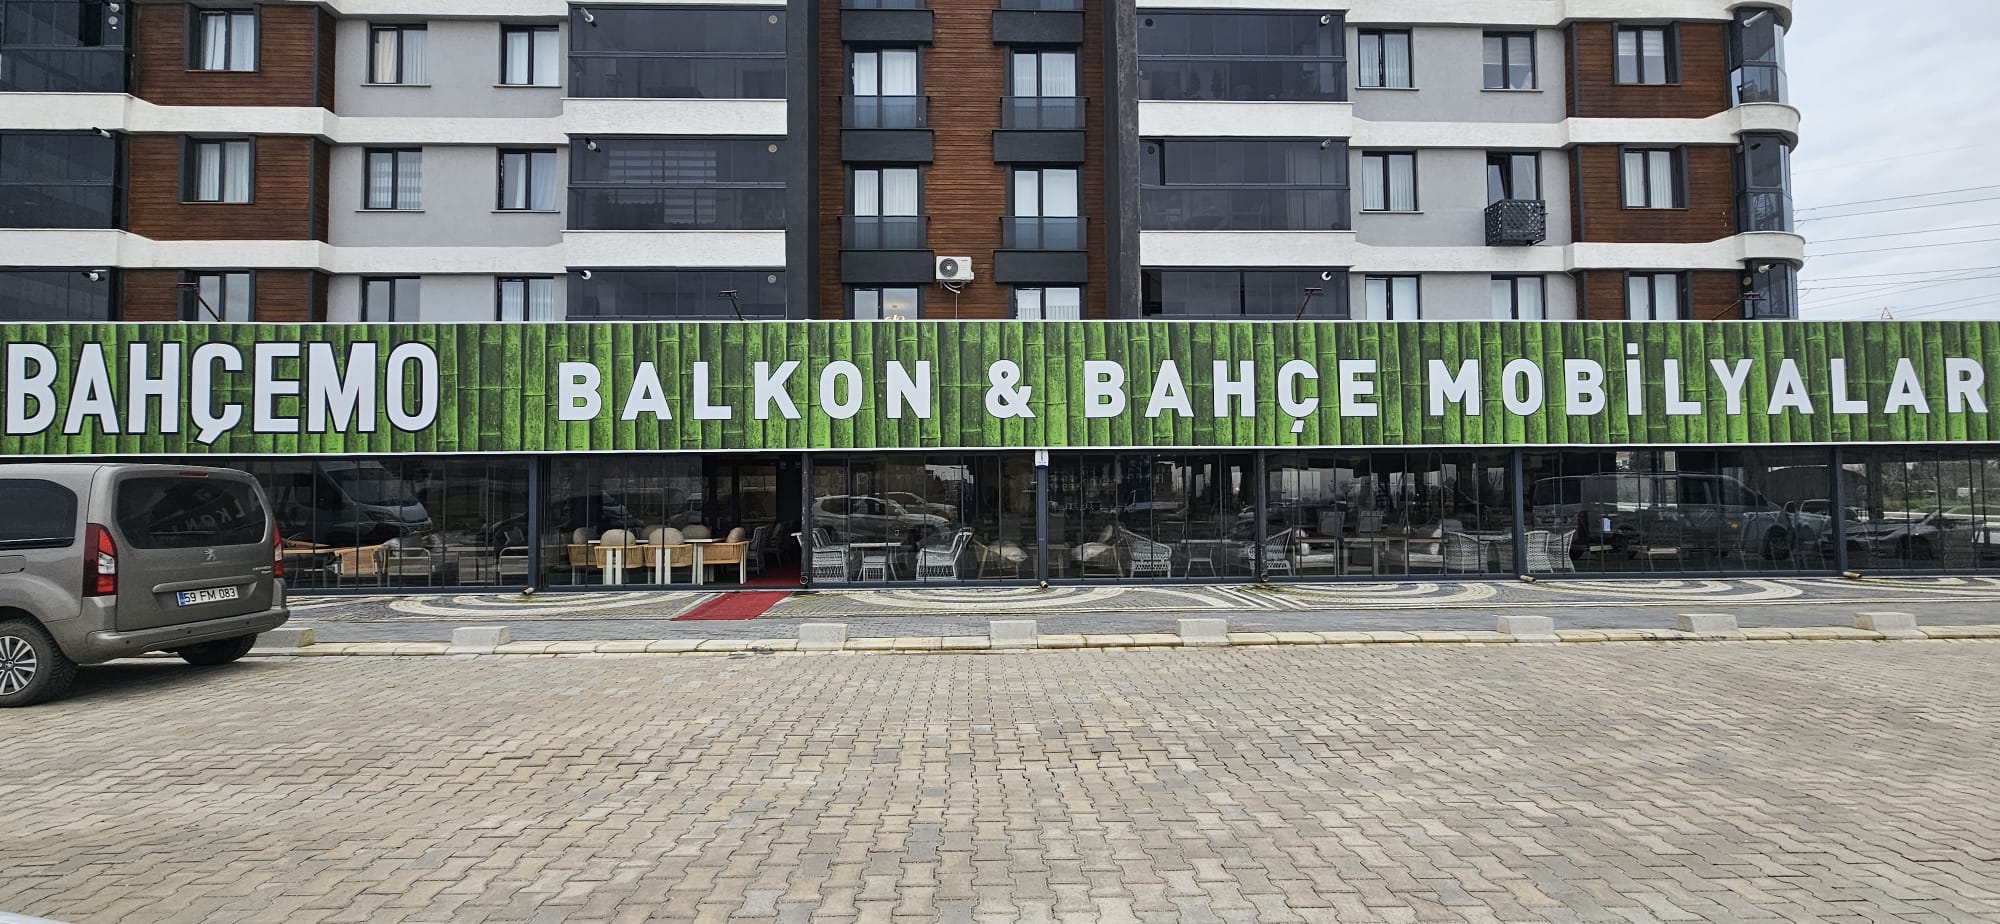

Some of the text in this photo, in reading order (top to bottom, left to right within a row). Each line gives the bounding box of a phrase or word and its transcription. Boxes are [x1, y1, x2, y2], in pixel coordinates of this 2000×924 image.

[5, 341, 440, 444] BAHÇEMO
[557, 342, 1988, 433] BALKON & BAHÇE MOBİLYALAR
[184, 587, 236, 603] 59 FM 083
